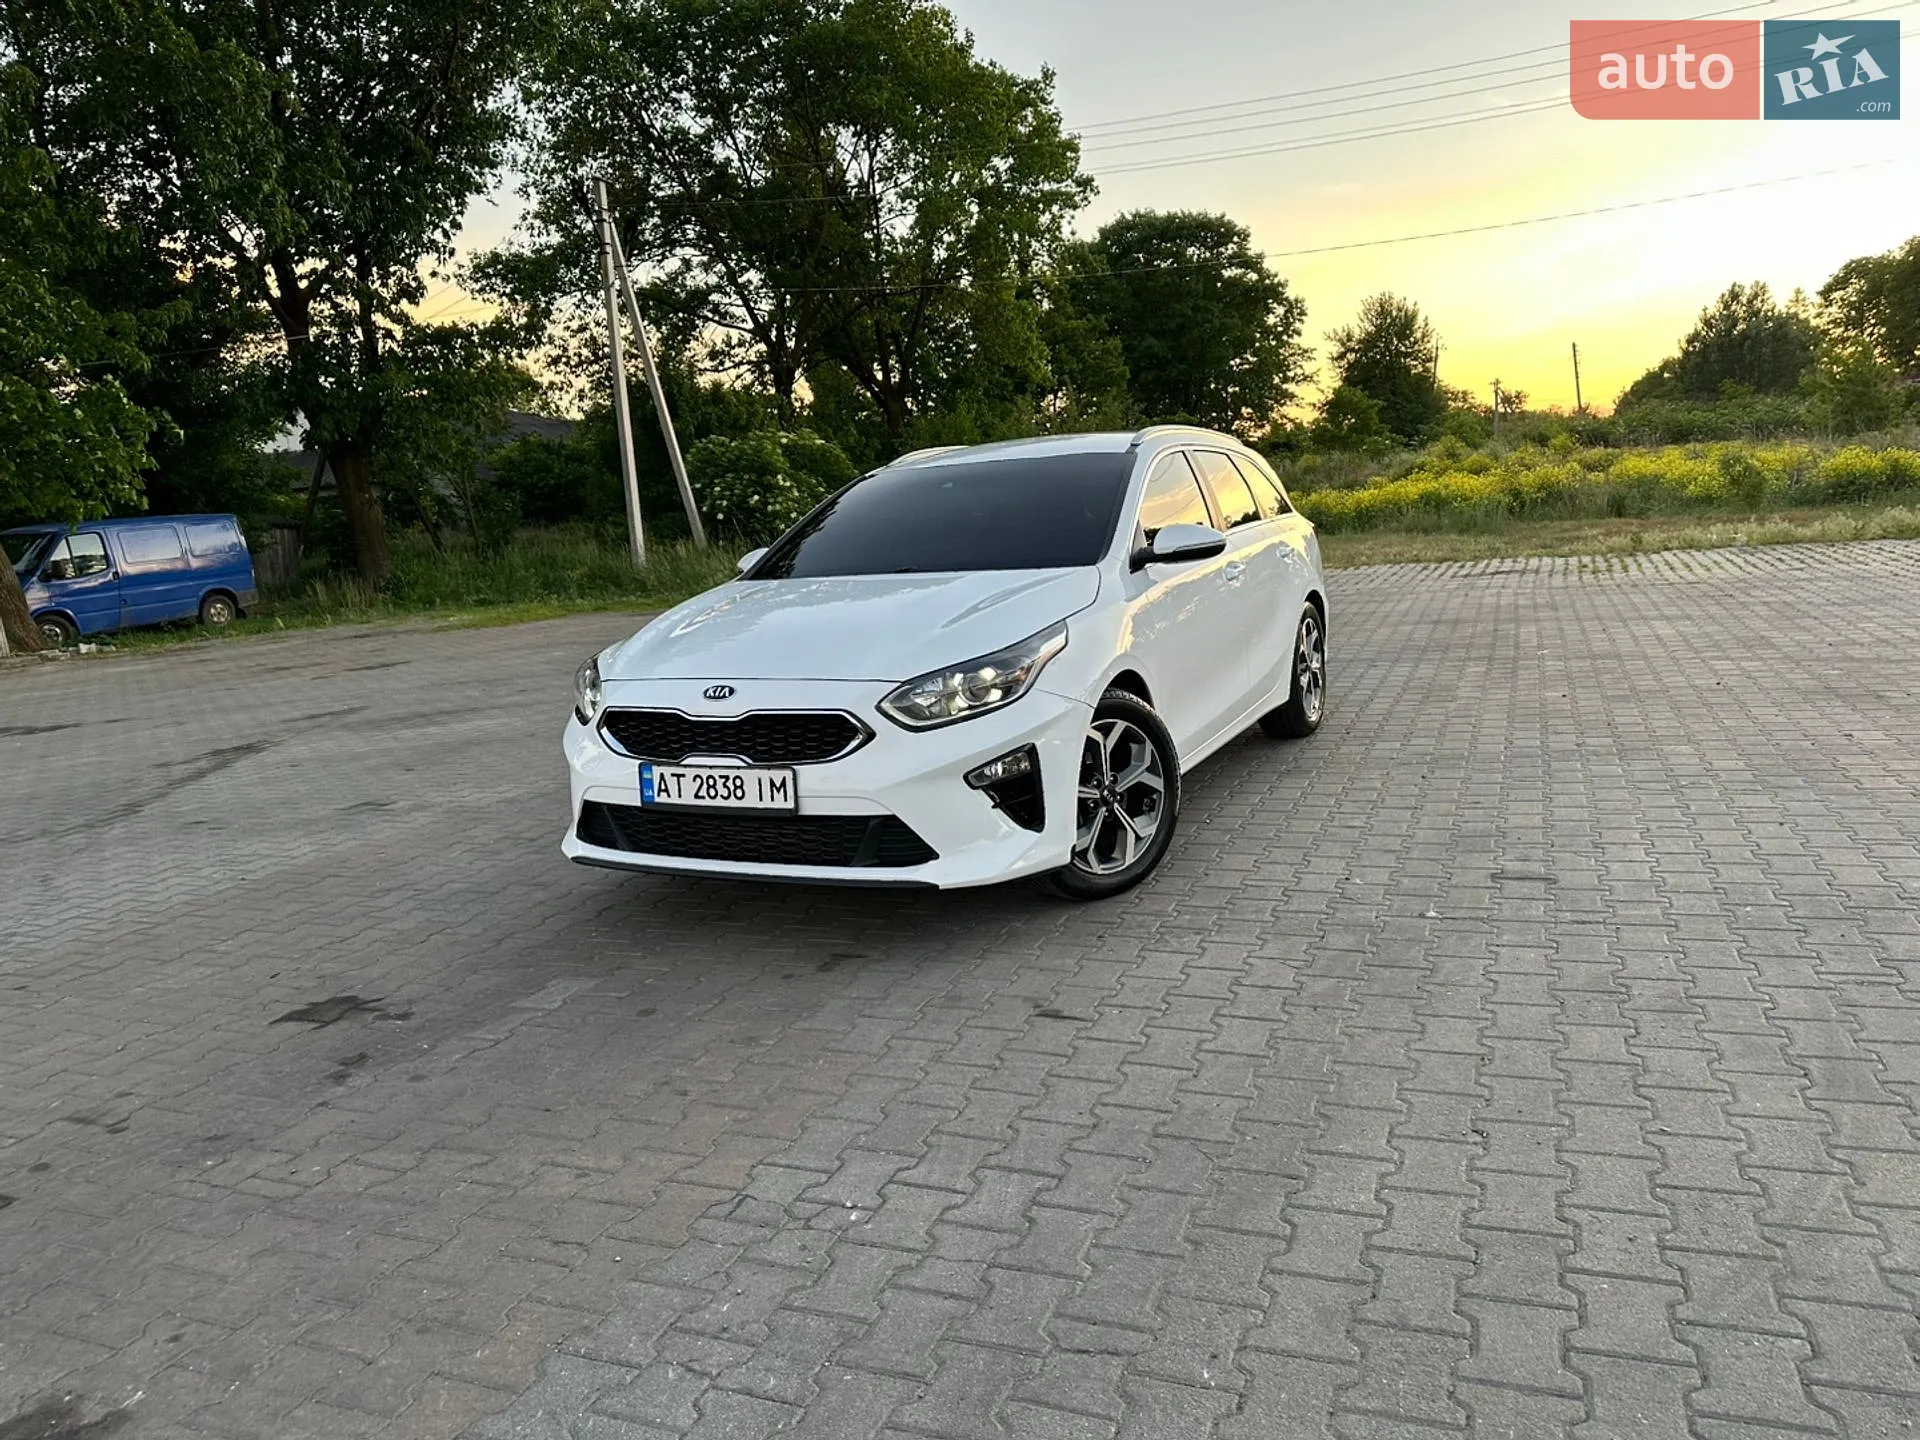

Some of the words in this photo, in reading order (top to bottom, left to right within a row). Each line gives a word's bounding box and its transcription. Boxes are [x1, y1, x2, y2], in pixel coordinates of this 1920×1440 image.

[706, 686, 730, 698] KIA
[656, 772, 686, 799] AT
[692, 774, 746, 801] 2838
[757, 776, 789, 803] IM
